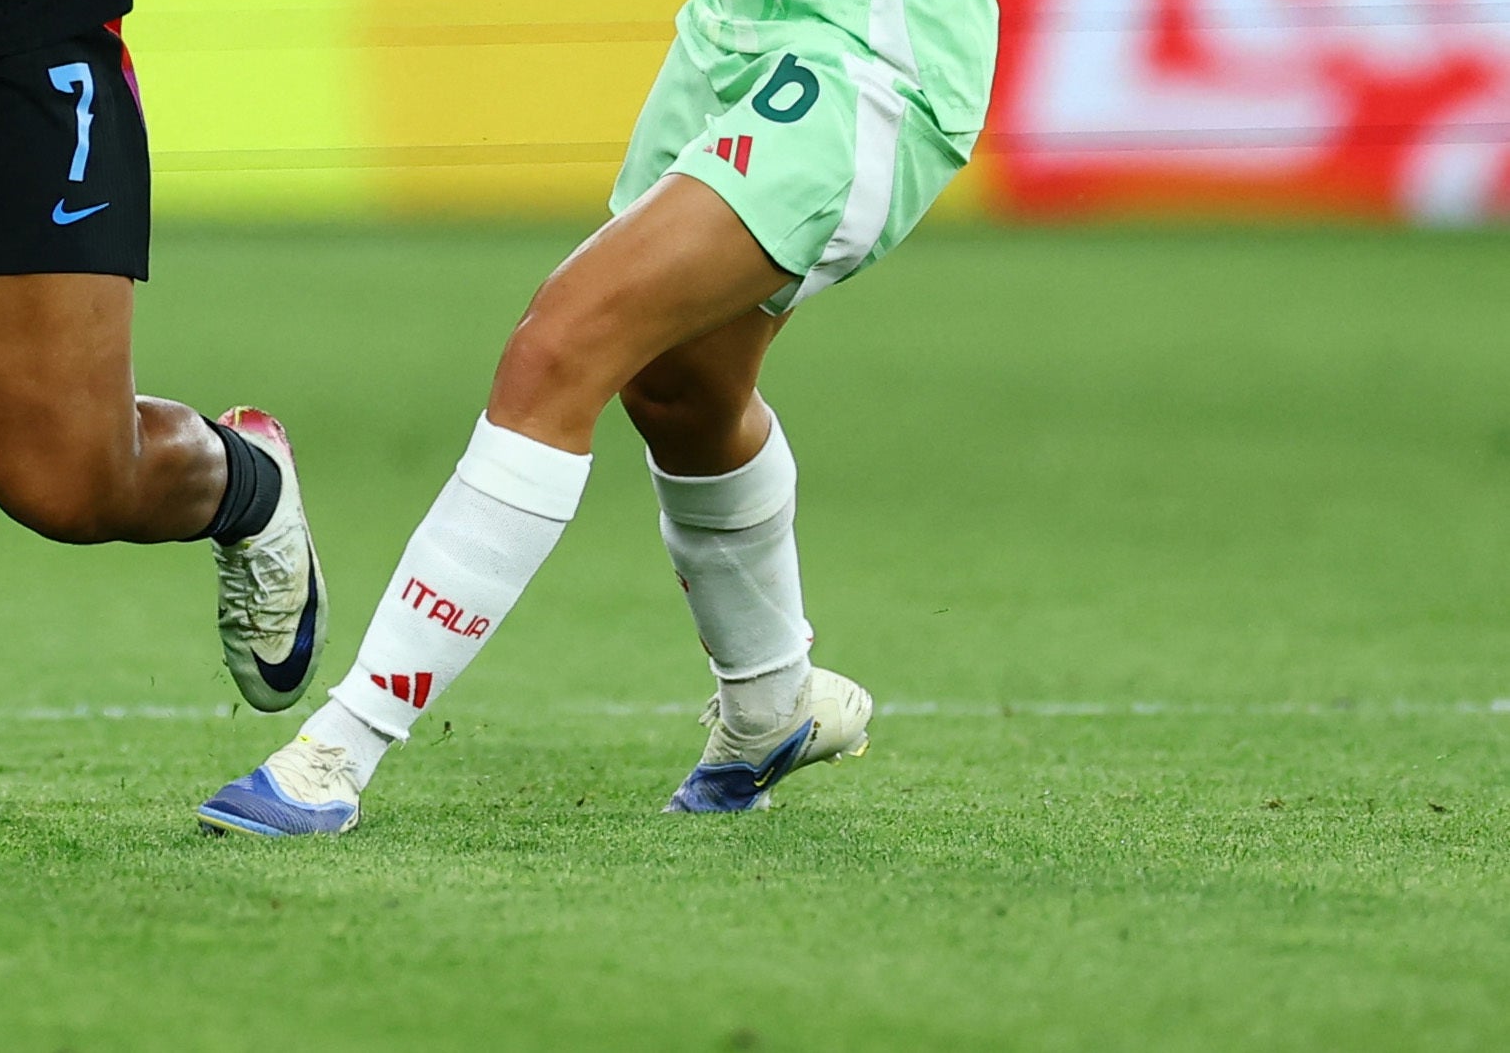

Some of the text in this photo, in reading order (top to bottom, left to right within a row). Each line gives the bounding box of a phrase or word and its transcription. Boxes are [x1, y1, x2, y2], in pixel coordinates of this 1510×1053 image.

[48, 62, 95, 182] 7
[751, 52, 820, 124] 6
[401, 577, 491, 640] ITALIA
